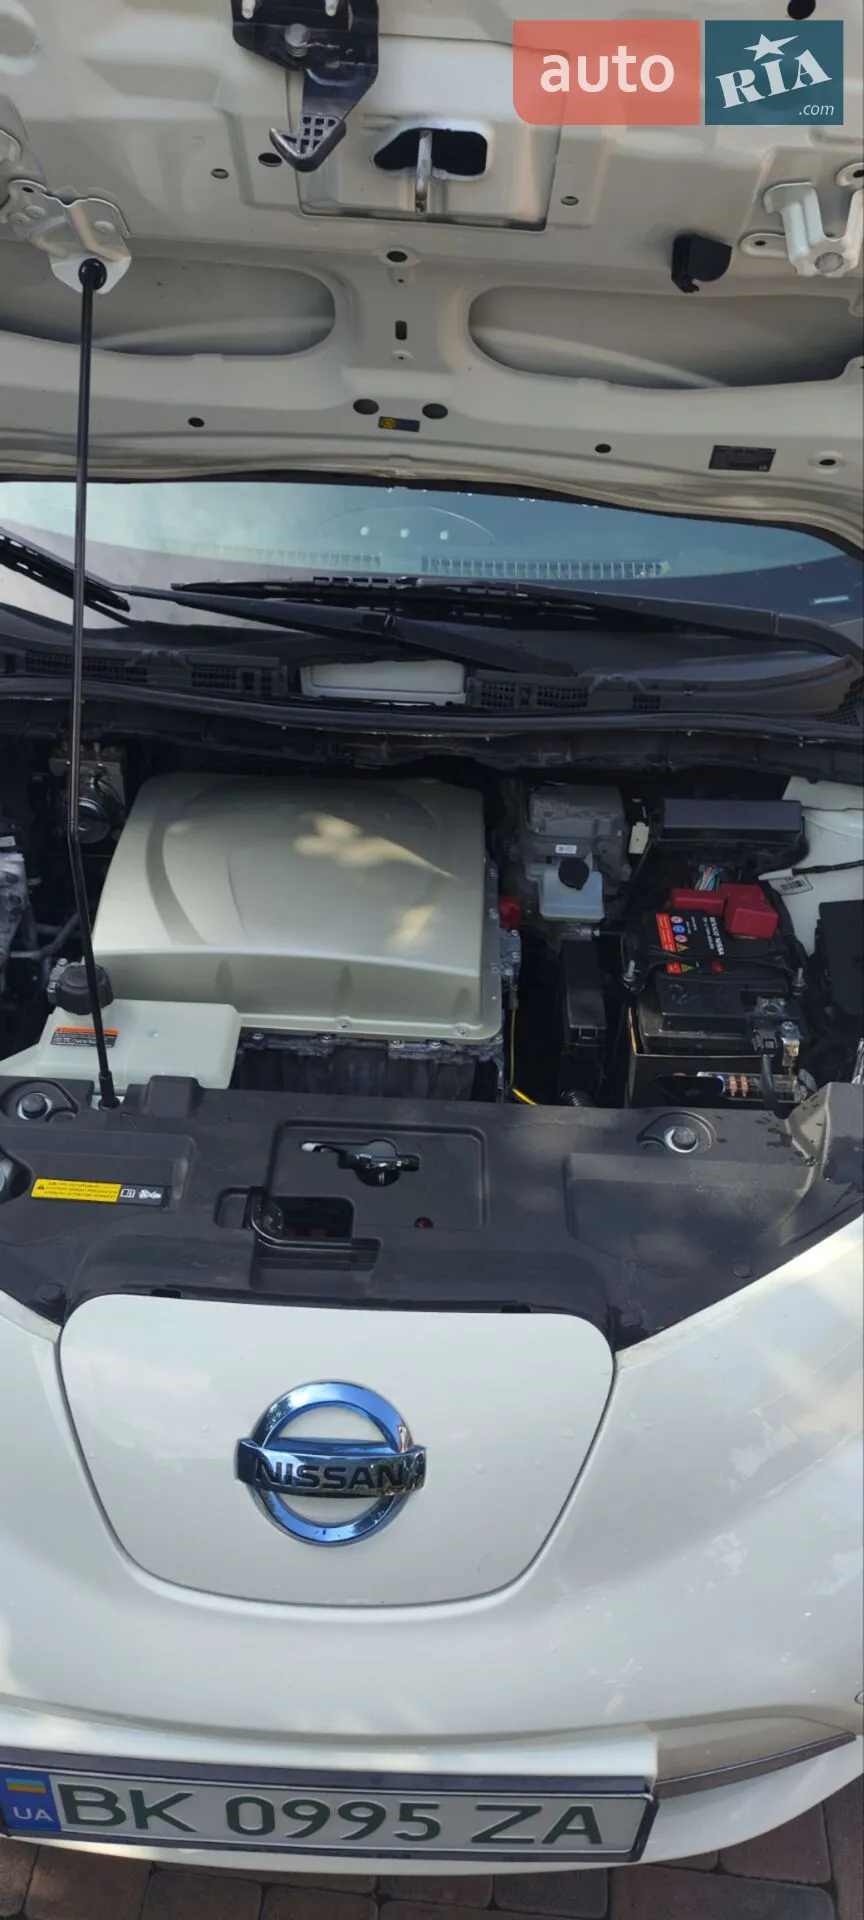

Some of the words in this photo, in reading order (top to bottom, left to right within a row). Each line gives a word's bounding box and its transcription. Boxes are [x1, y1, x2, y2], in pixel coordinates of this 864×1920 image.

[255, 1456, 404, 1490] NISSAN
[13, 1806, 53, 1822] UA
[57, 1783, 198, 1833] BK
[225, 1795, 441, 1842] 0995
[471, 1803, 603, 1845] ZA
